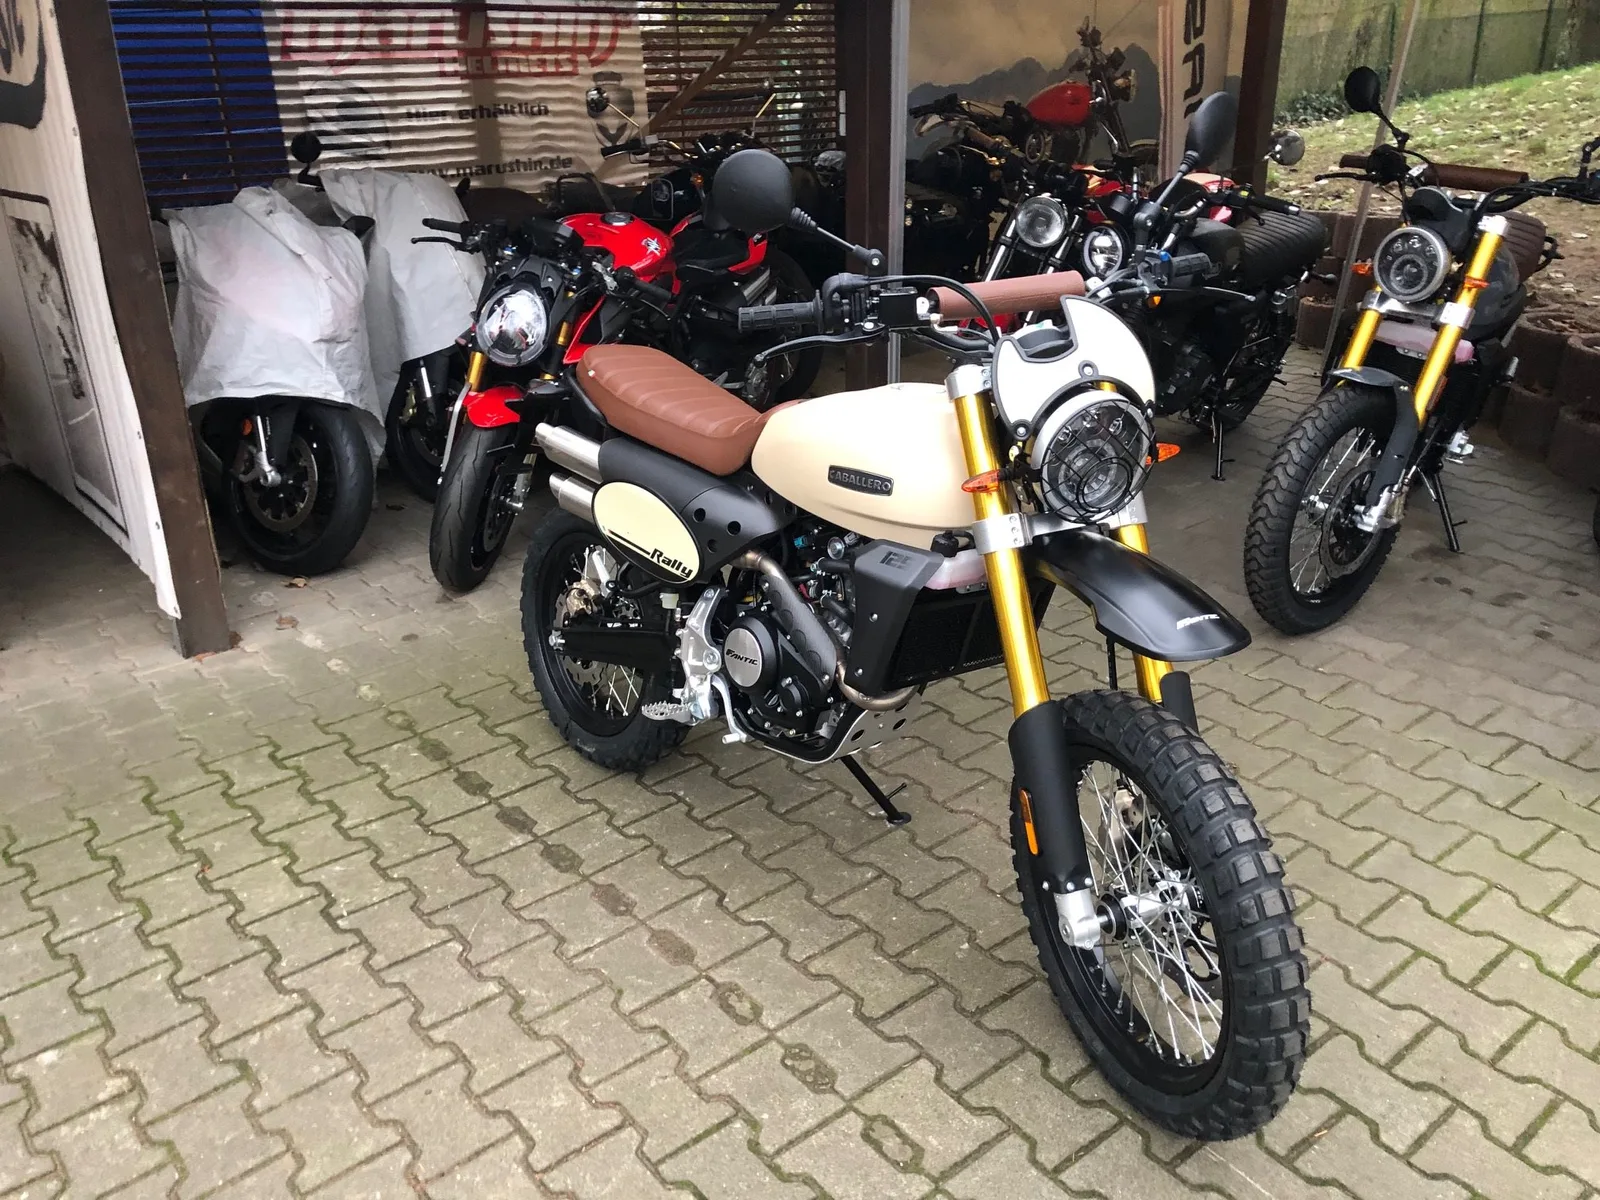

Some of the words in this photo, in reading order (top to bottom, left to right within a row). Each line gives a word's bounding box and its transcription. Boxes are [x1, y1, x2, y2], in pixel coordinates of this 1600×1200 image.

[458, 102, 550, 120] erhältlich
[829, 470, 891, 491] CABALLERO
[650, 548, 693, 578] Rally
[726, 648, 758, 666] FANTIC
